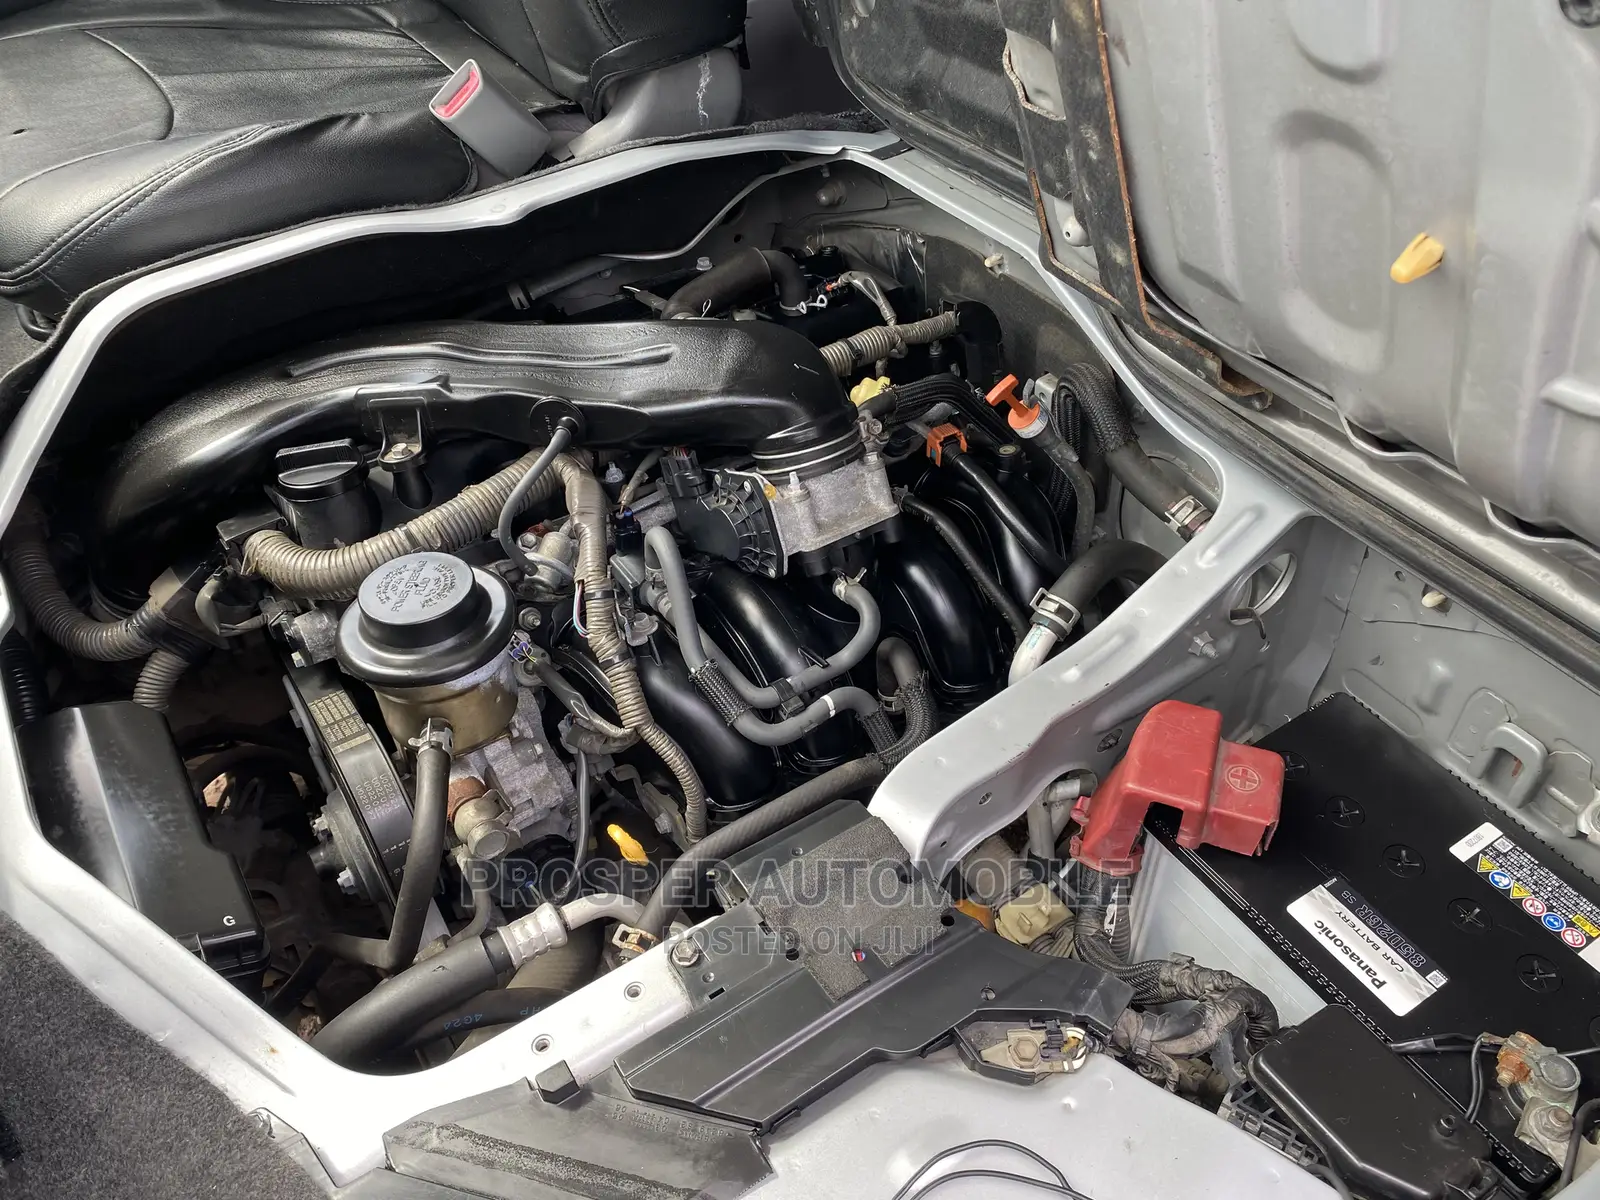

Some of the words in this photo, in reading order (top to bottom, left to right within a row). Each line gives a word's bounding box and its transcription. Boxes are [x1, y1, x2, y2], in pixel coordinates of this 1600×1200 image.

[1341, 890, 1356, 905] SB
[223, 915, 237, 927] G
[1334, 910, 1381, 952] BATTERY
[1355, 904, 1427, 969] 85D26R
[1314, 919, 1387, 990] Panasonic
[1382, 952, 1405, 973] CAR
